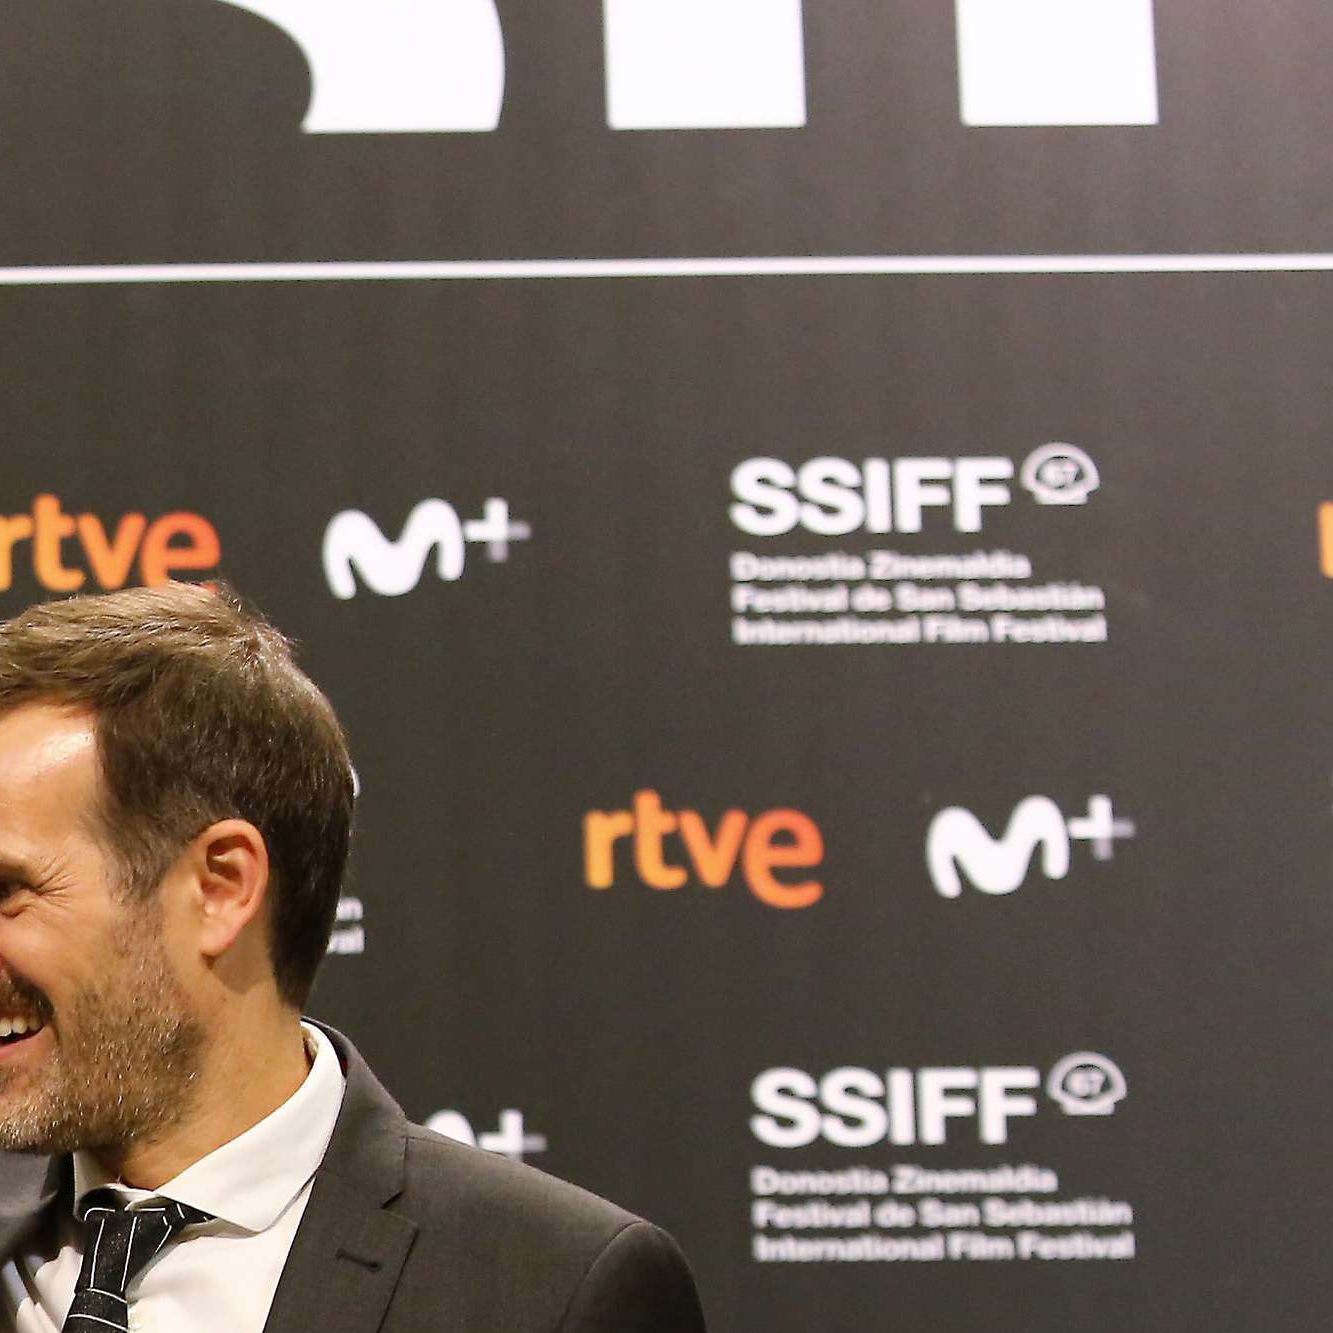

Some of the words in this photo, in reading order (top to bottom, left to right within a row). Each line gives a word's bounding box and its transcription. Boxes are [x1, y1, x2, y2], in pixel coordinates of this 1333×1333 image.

[729, 457, 1013, 536] SSIFF
[731, 551, 866, 580] Donostia
[870, 550, 1032, 578] Zinemaldia
[731, 584, 848, 612] Festival
[853, 583, 892, 611] de
[895, 583, 955, 611] San
[732, 616, 921, 645] International
[924, 615, 990, 643] Film
[993, 614, 1107, 642] Festival
[583, 789, 824, 909] rtve
[750, 1067, 1039, 1149] SSIFF
[751, 1165, 888, 1195] Donostia
[891, 1164, 1058, 1193] Zinemaldia
[752, 1198, 870, 1228] Festival
[875, 1199, 915, 1228] de
[918, 1199, 979, 1227] San
[753, 1233, 944, 1262] International
[948, 1232, 1014, 1260] Film
[1018, 1230, 1135, 1258] Festival
